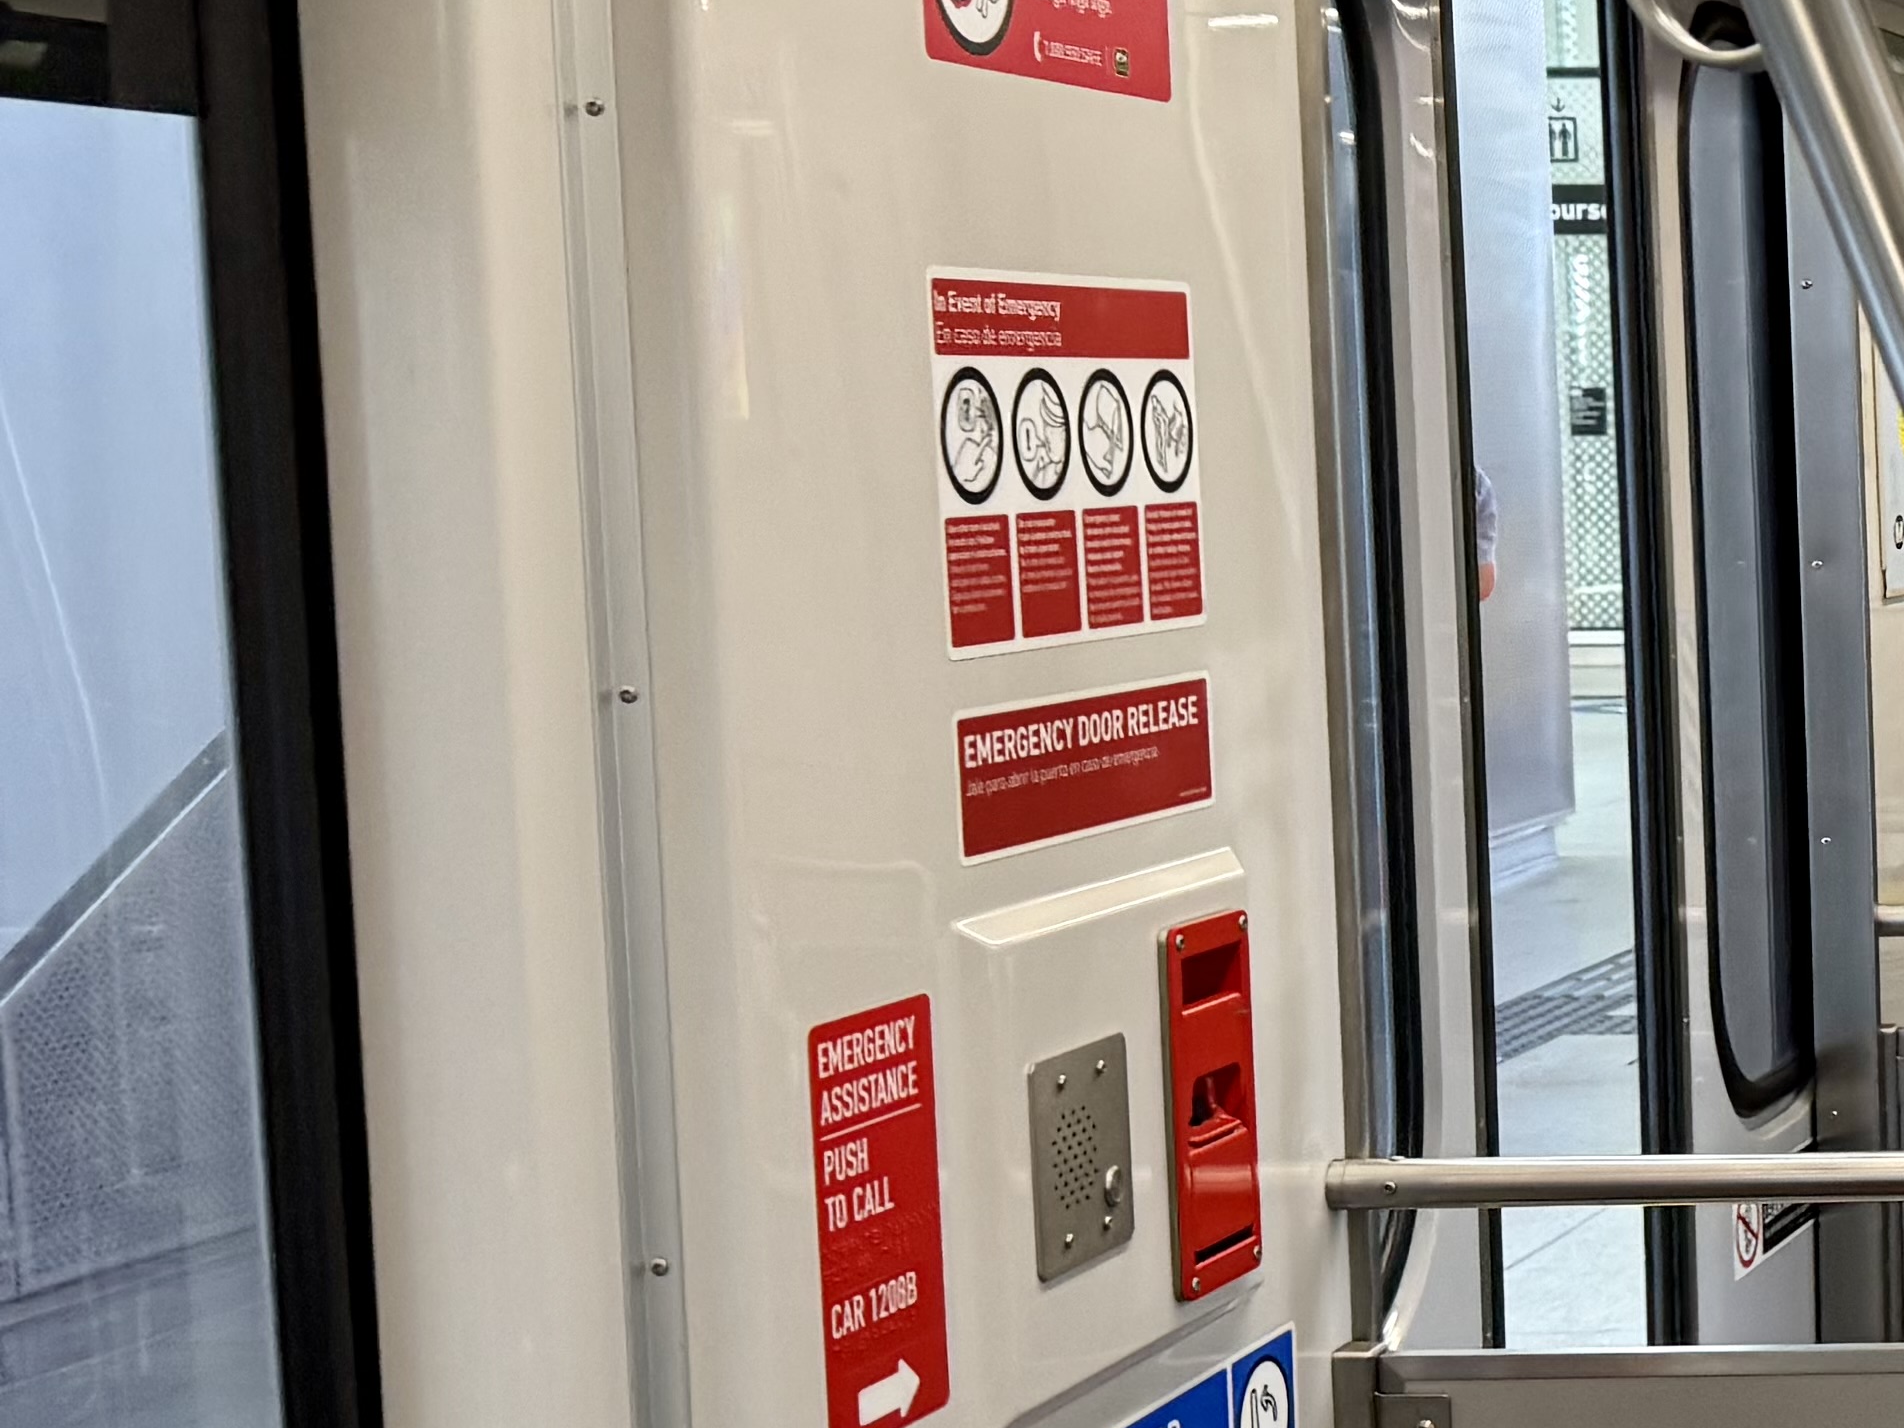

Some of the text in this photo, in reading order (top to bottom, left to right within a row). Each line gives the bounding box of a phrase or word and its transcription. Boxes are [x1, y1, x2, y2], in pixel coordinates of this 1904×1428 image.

[964, 695, 1199, 768] EMERGENCY DOOR RELEASE
[817, 1015, 917, 1080] EMERGENCY
[820, 1060, 920, 1127] ASSISTANCE
[823, 1137, 870, 1186] PUSH
[824, 1176, 895, 1232] TO CALL
[831, 1294, 866, 1340] CAR
